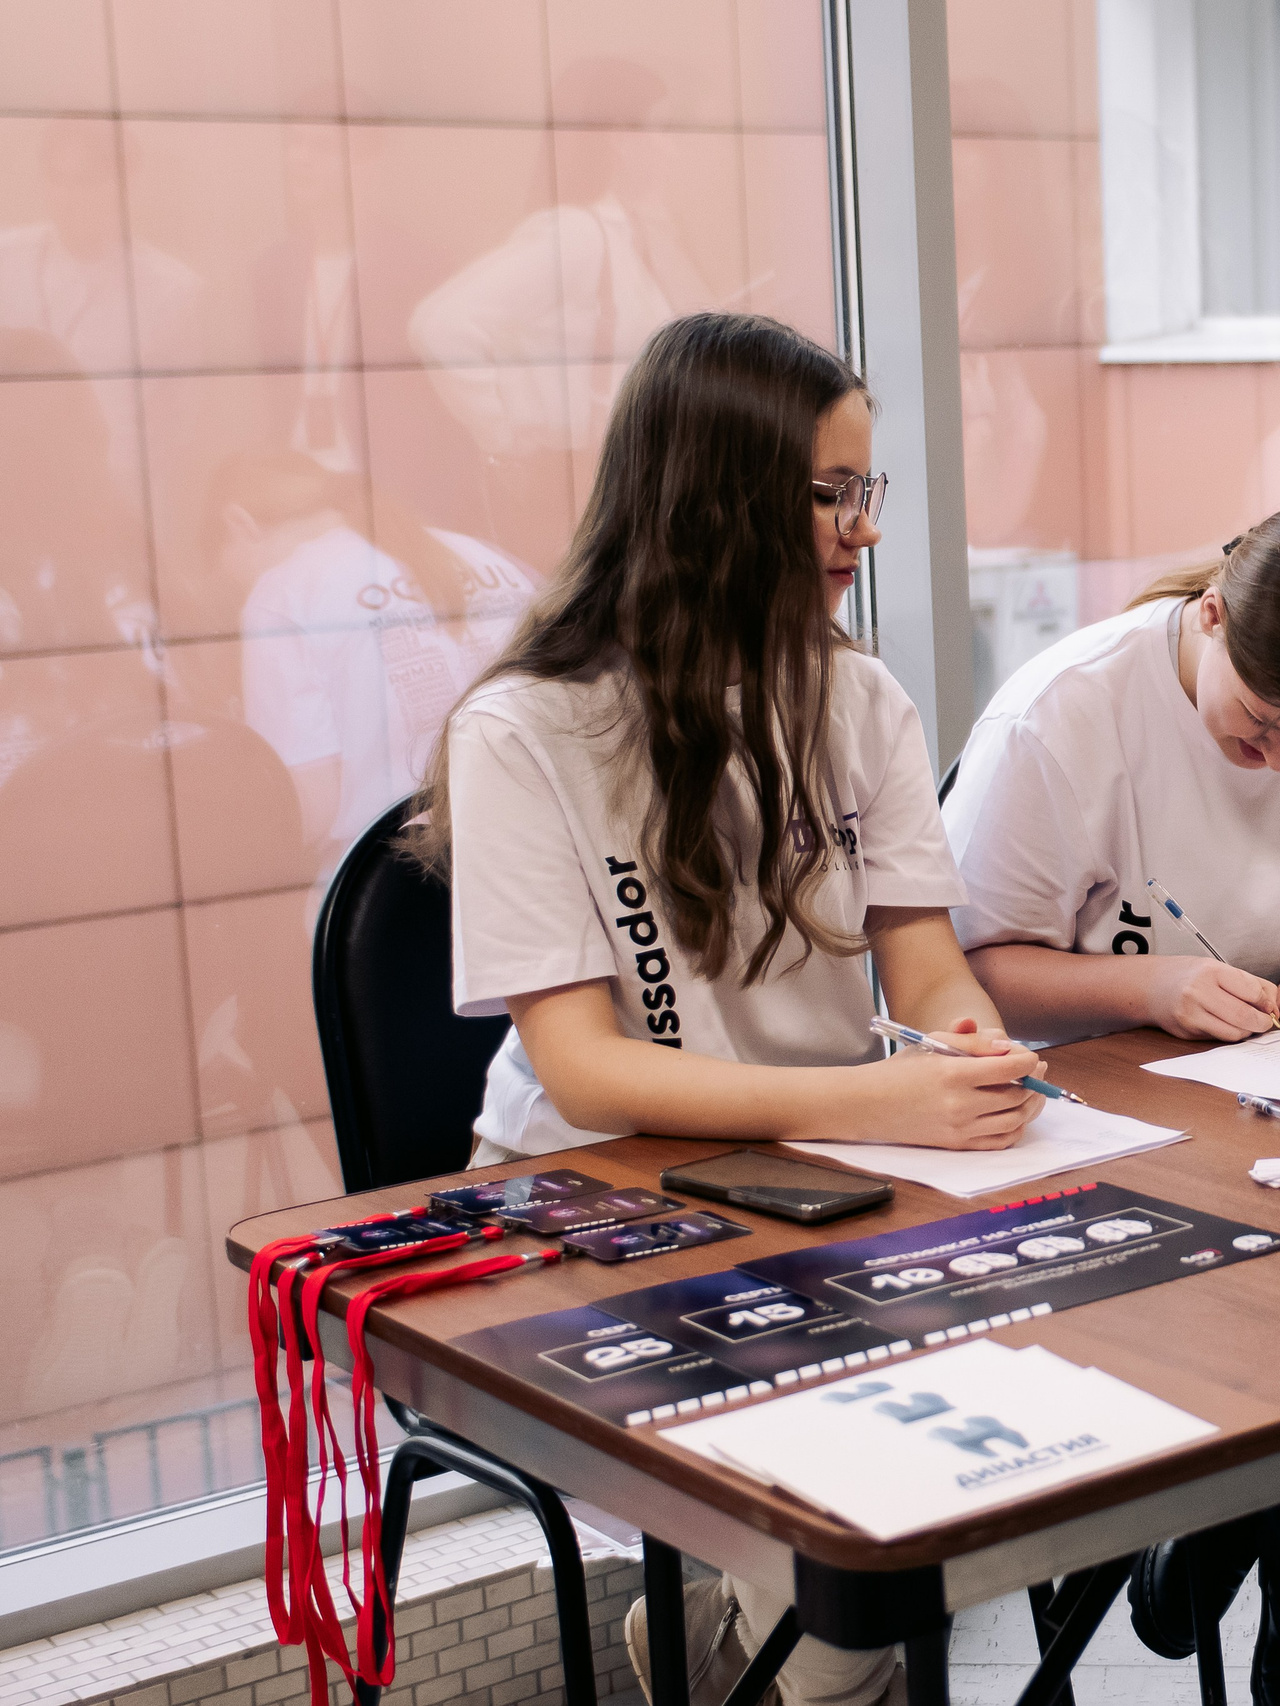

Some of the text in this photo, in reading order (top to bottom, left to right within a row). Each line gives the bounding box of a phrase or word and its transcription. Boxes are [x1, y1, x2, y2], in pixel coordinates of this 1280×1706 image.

[871, 1267, 946, 1291] 10
[728, 1302, 806, 1328] 15
[584, 1337, 674, 1369] 25
[955, 1433, 1102, 1488] ДИНАСТИЯ
